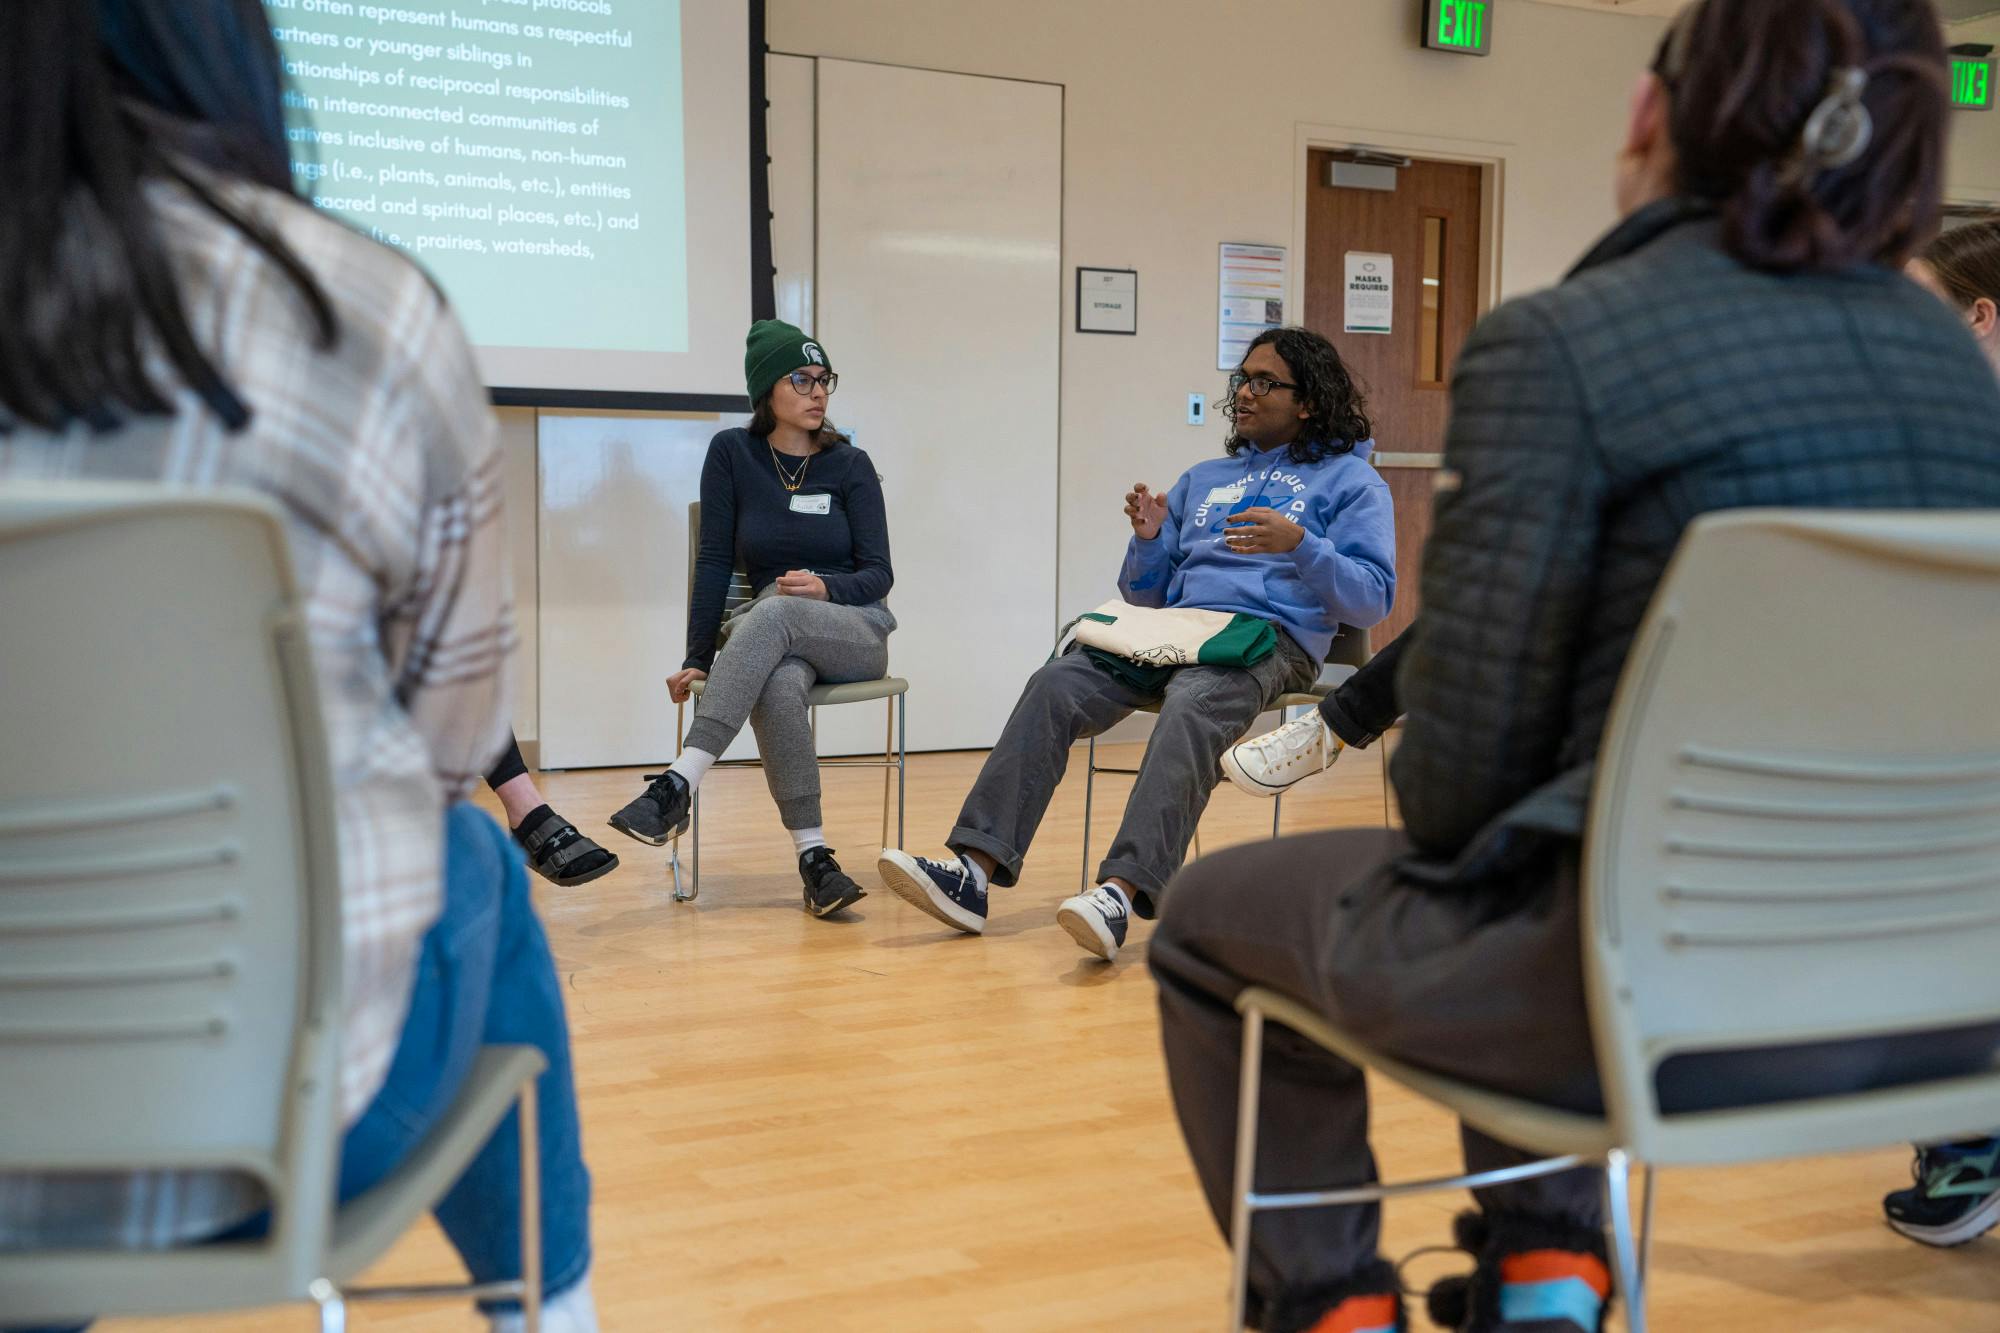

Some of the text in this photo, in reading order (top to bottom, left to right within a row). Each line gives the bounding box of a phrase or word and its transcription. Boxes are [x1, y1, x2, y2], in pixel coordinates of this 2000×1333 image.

[302, 0, 354, 16] often
[358, 4, 447, 28] represent
[451, 9, 520, 36] humans
[523, 24, 544, 39] as
[548, 27, 633, 48] respectful
[1438, 0, 1487, 48] EXIT
[271, 26, 533, 70] artners or younger siblings in
[281, 54, 630, 109] lationships of reciprocal responsibilities
[323, 95, 464, 124] interconnected
[468, 112, 577, 134] communities
[581, 118, 600, 136] of
[348, 129, 426, 153] inclusive
[430, 135, 450, 154] of
[454, 136, 527, 163] humans,
[531, 146, 626, 169] non-human
[332, 158, 374, 183] (i.e.,
[378, 163, 440, 187] plants,
[444, 171, 517, 193] animals,
[520, 176, 566, 199] etc.),
[570, 181, 631, 200] entities
[313, 194, 639, 232] sacred and spiritual places, etc.) and
[416, 234, 487, 254] prairies,
[491, 237, 595, 260] watersheds,
[1350, 283, 1389, 291] REQUIRED
[1355, 275, 1382, 283] MASKS
